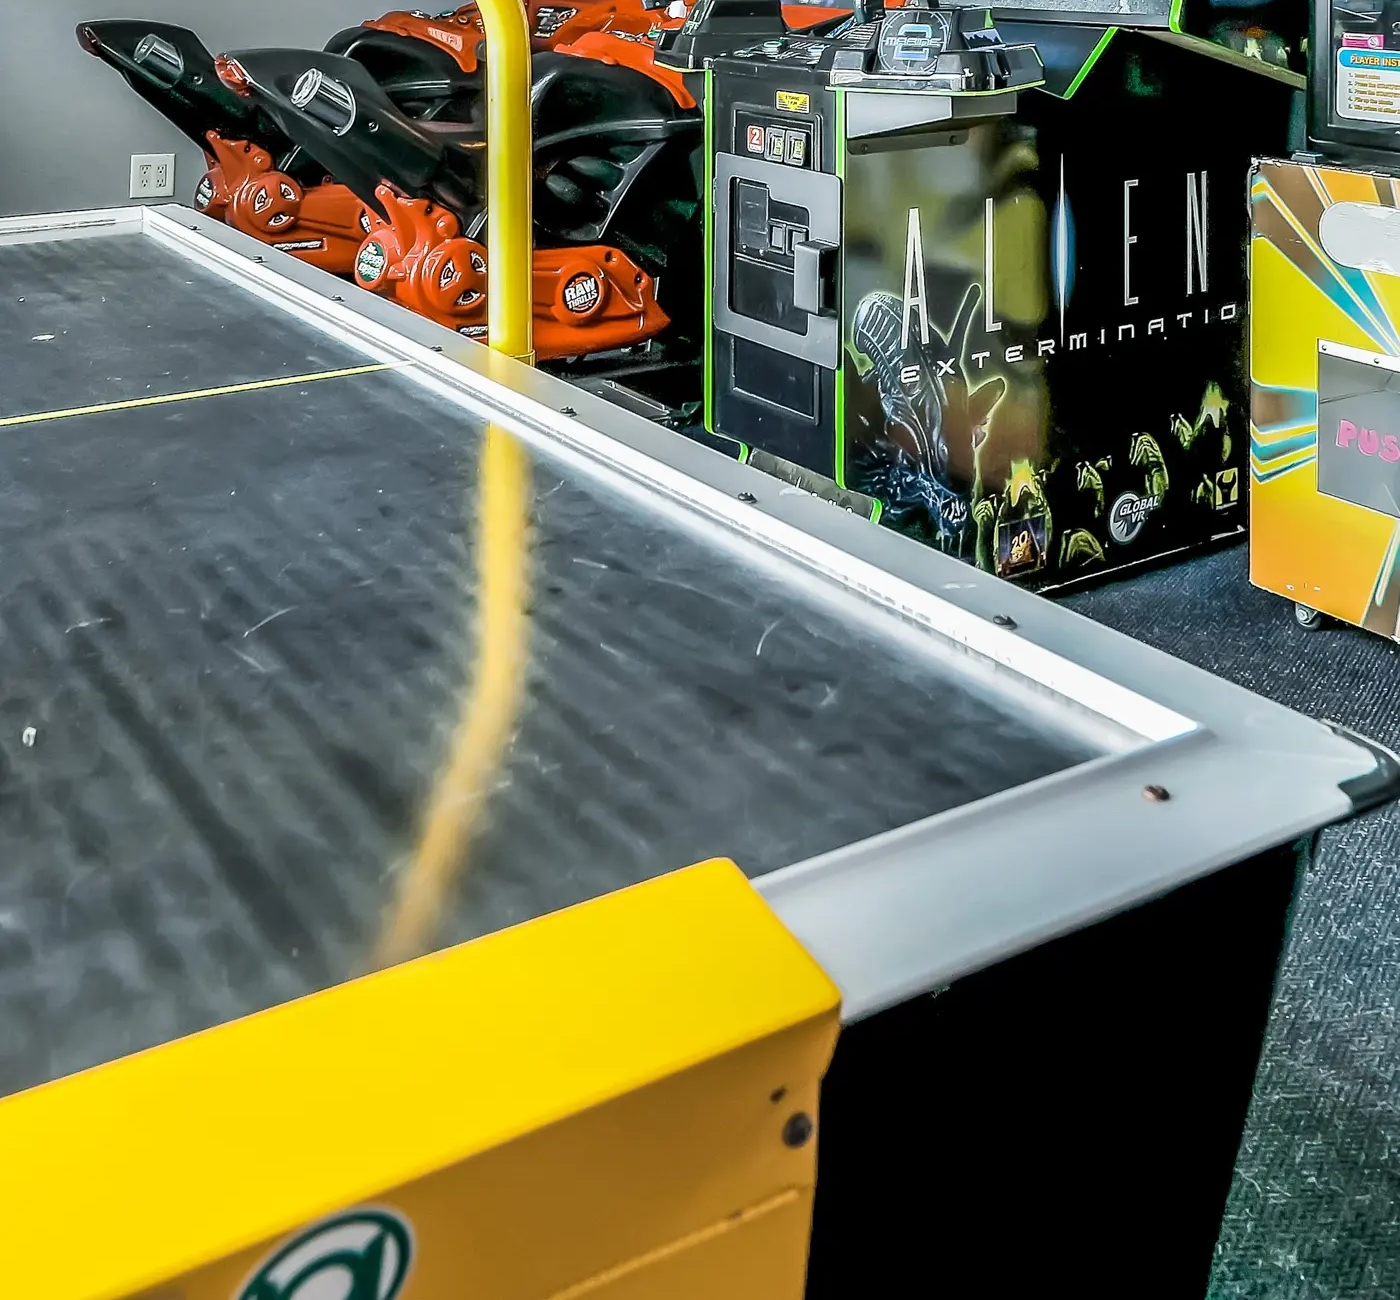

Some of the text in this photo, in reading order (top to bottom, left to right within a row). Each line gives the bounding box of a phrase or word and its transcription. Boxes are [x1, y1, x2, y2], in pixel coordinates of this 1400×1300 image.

[884, 35, 942, 48] MARINE
[1350, 54, 1380, 66] PLAYER
[749, 128, 761, 146] 2
[564, 276, 596, 301] RAW
[566, 290, 598, 310] THRILLS
[1119, 494, 1159, 517] GLOBAL
[1131, 511, 1146, 523] VR
